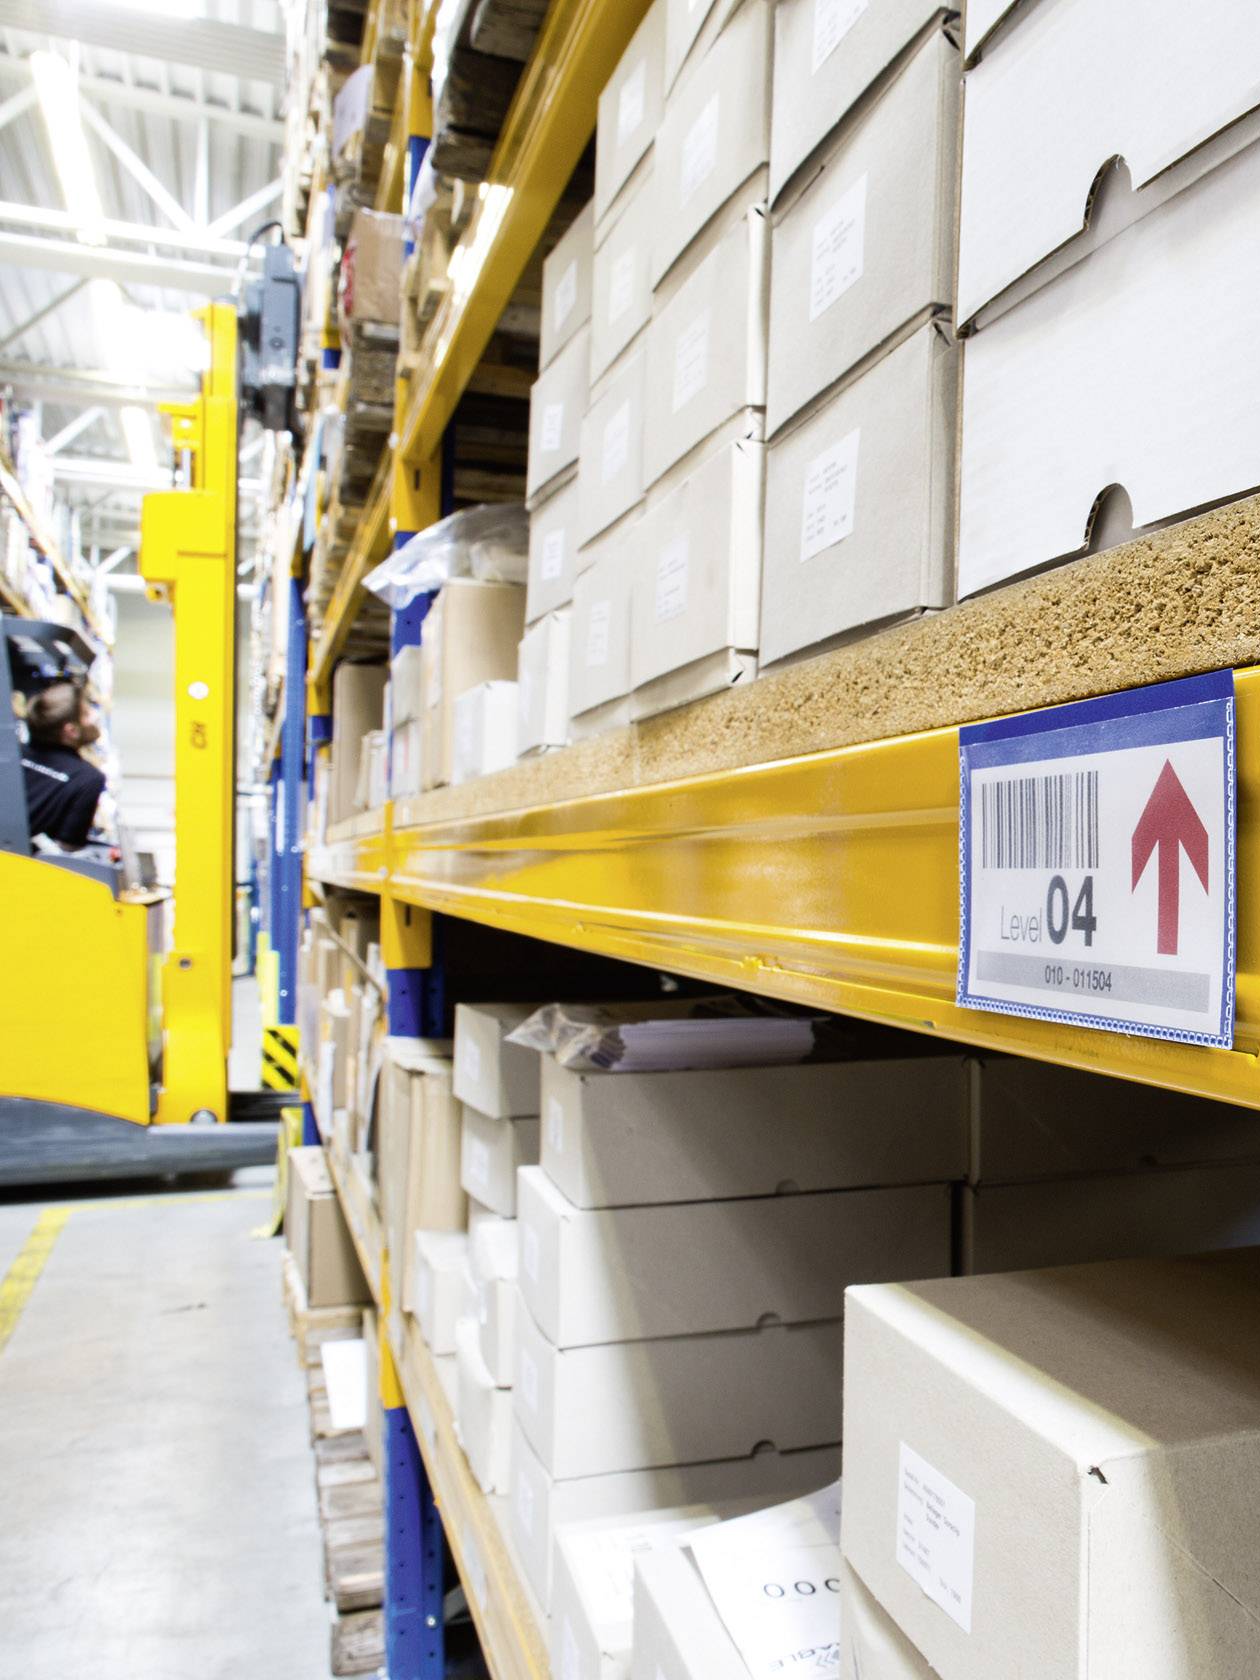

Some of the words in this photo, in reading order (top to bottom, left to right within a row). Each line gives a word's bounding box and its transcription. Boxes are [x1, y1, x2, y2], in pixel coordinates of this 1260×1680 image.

[1000, 905, 1042, 943] Level
[1046, 874, 1097, 947] 04
[1044, 964, 1063, 985] 010
[1073, 967, 1112, 993] 011504
